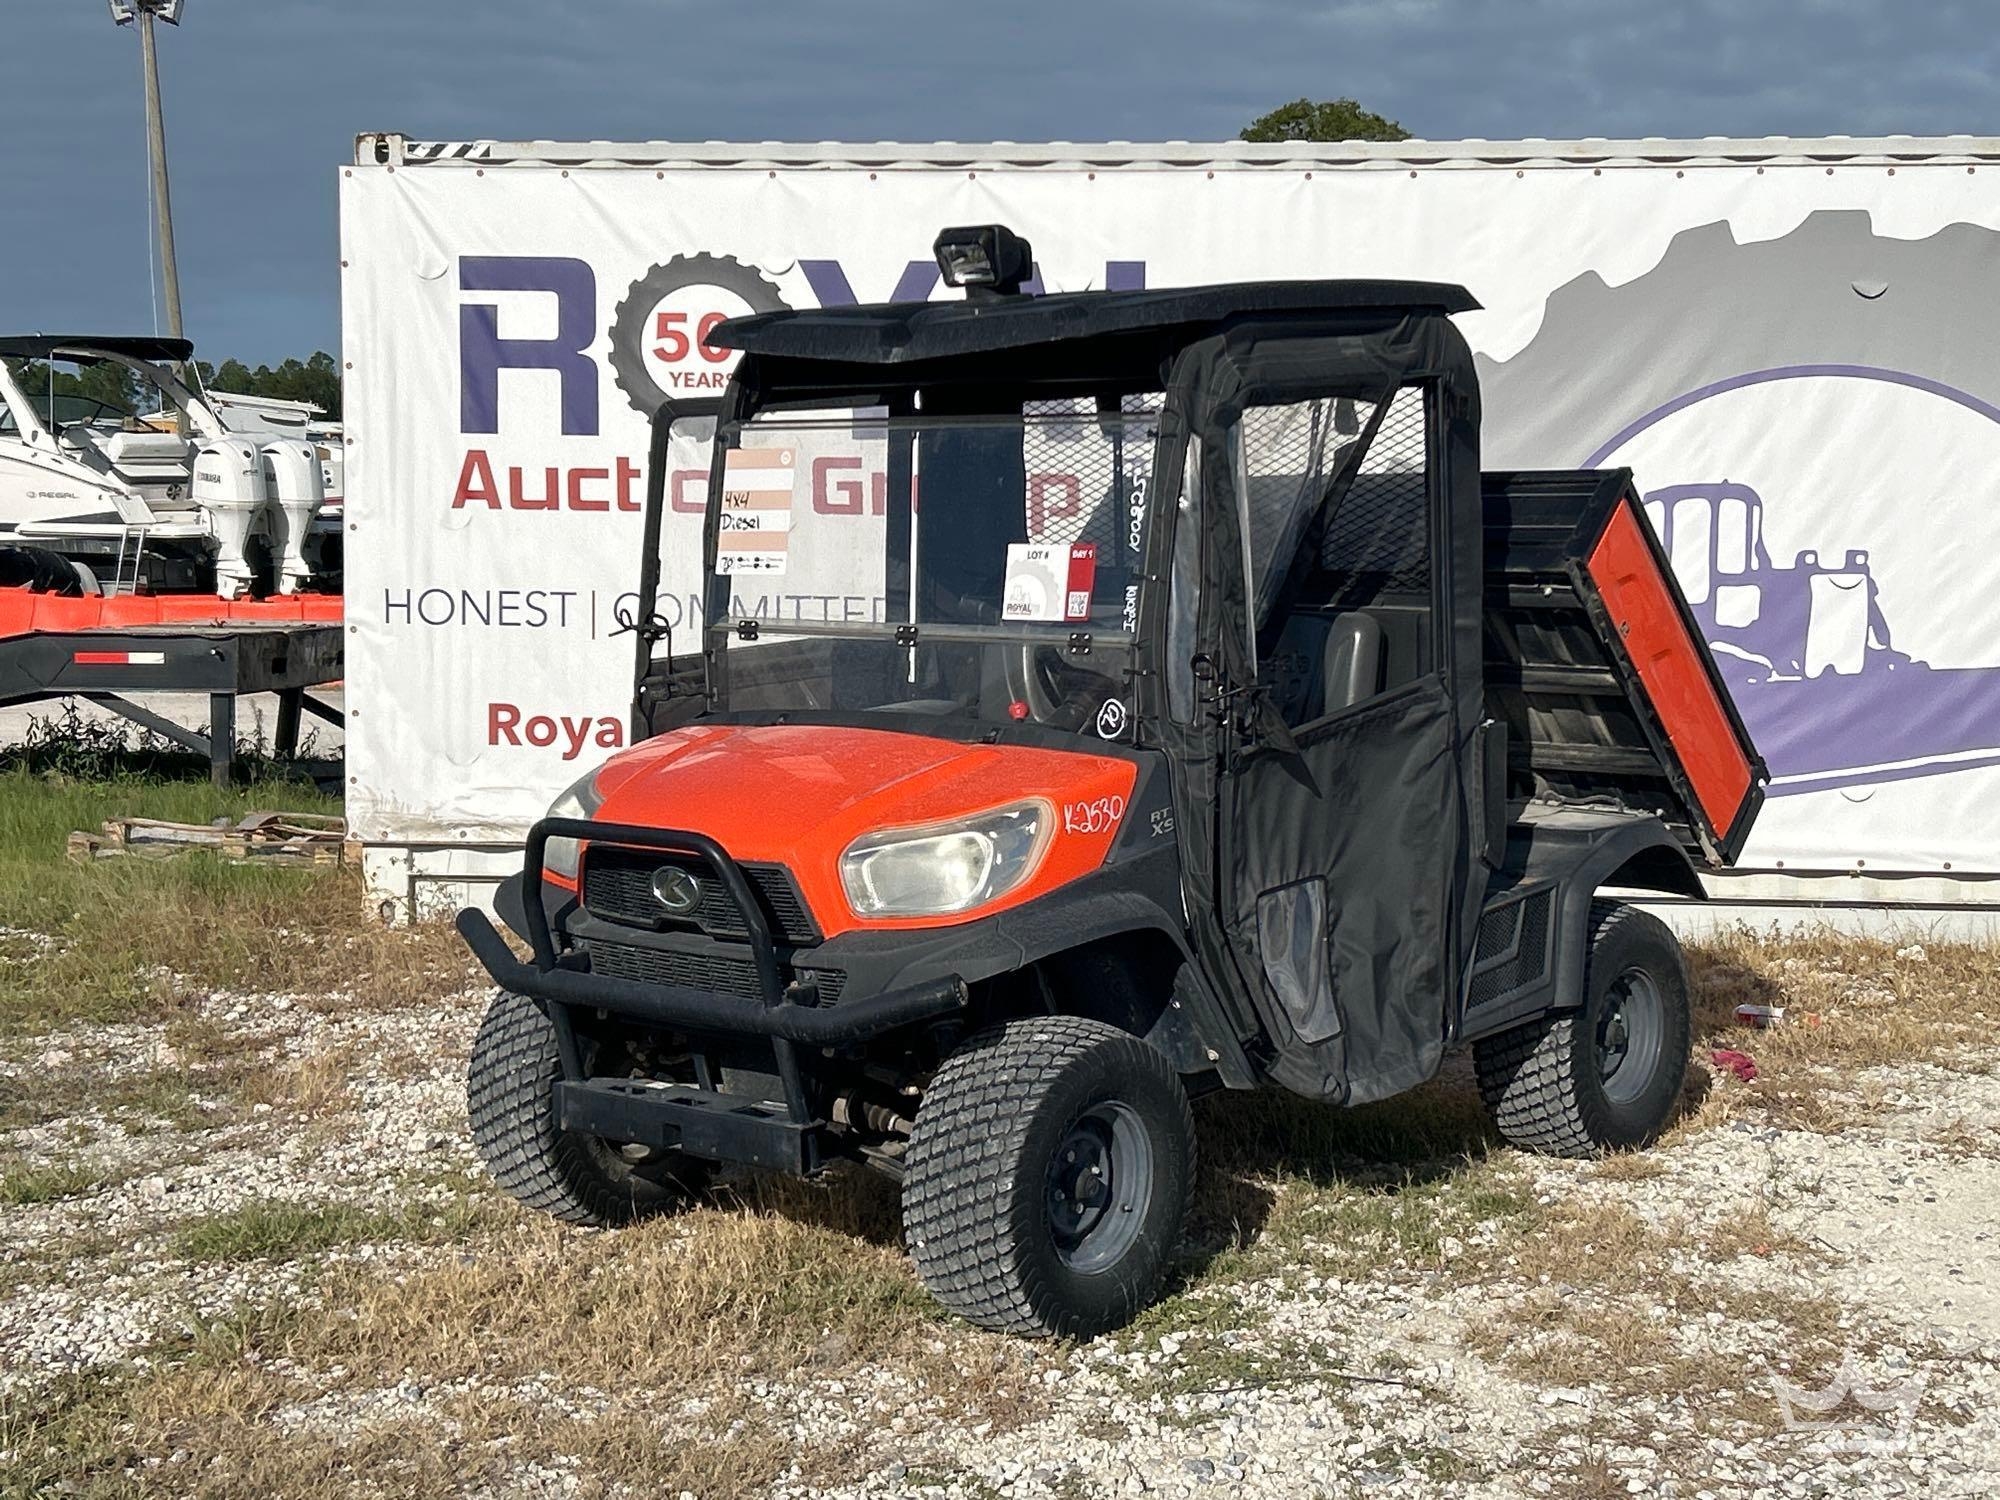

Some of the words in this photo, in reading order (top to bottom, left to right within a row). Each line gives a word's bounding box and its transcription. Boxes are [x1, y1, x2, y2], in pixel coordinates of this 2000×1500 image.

[652, 311, 734, 363] 50
[38, 491, 80, 499] REGAL
[1027, 551, 1044, 560] LOT
[1072, 550, 1087, 559] DAY
[385, 588, 577, 627] HONEST
[1006, 603, 1032, 613] ROYAL
[488, 703, 623, 760] Roya
